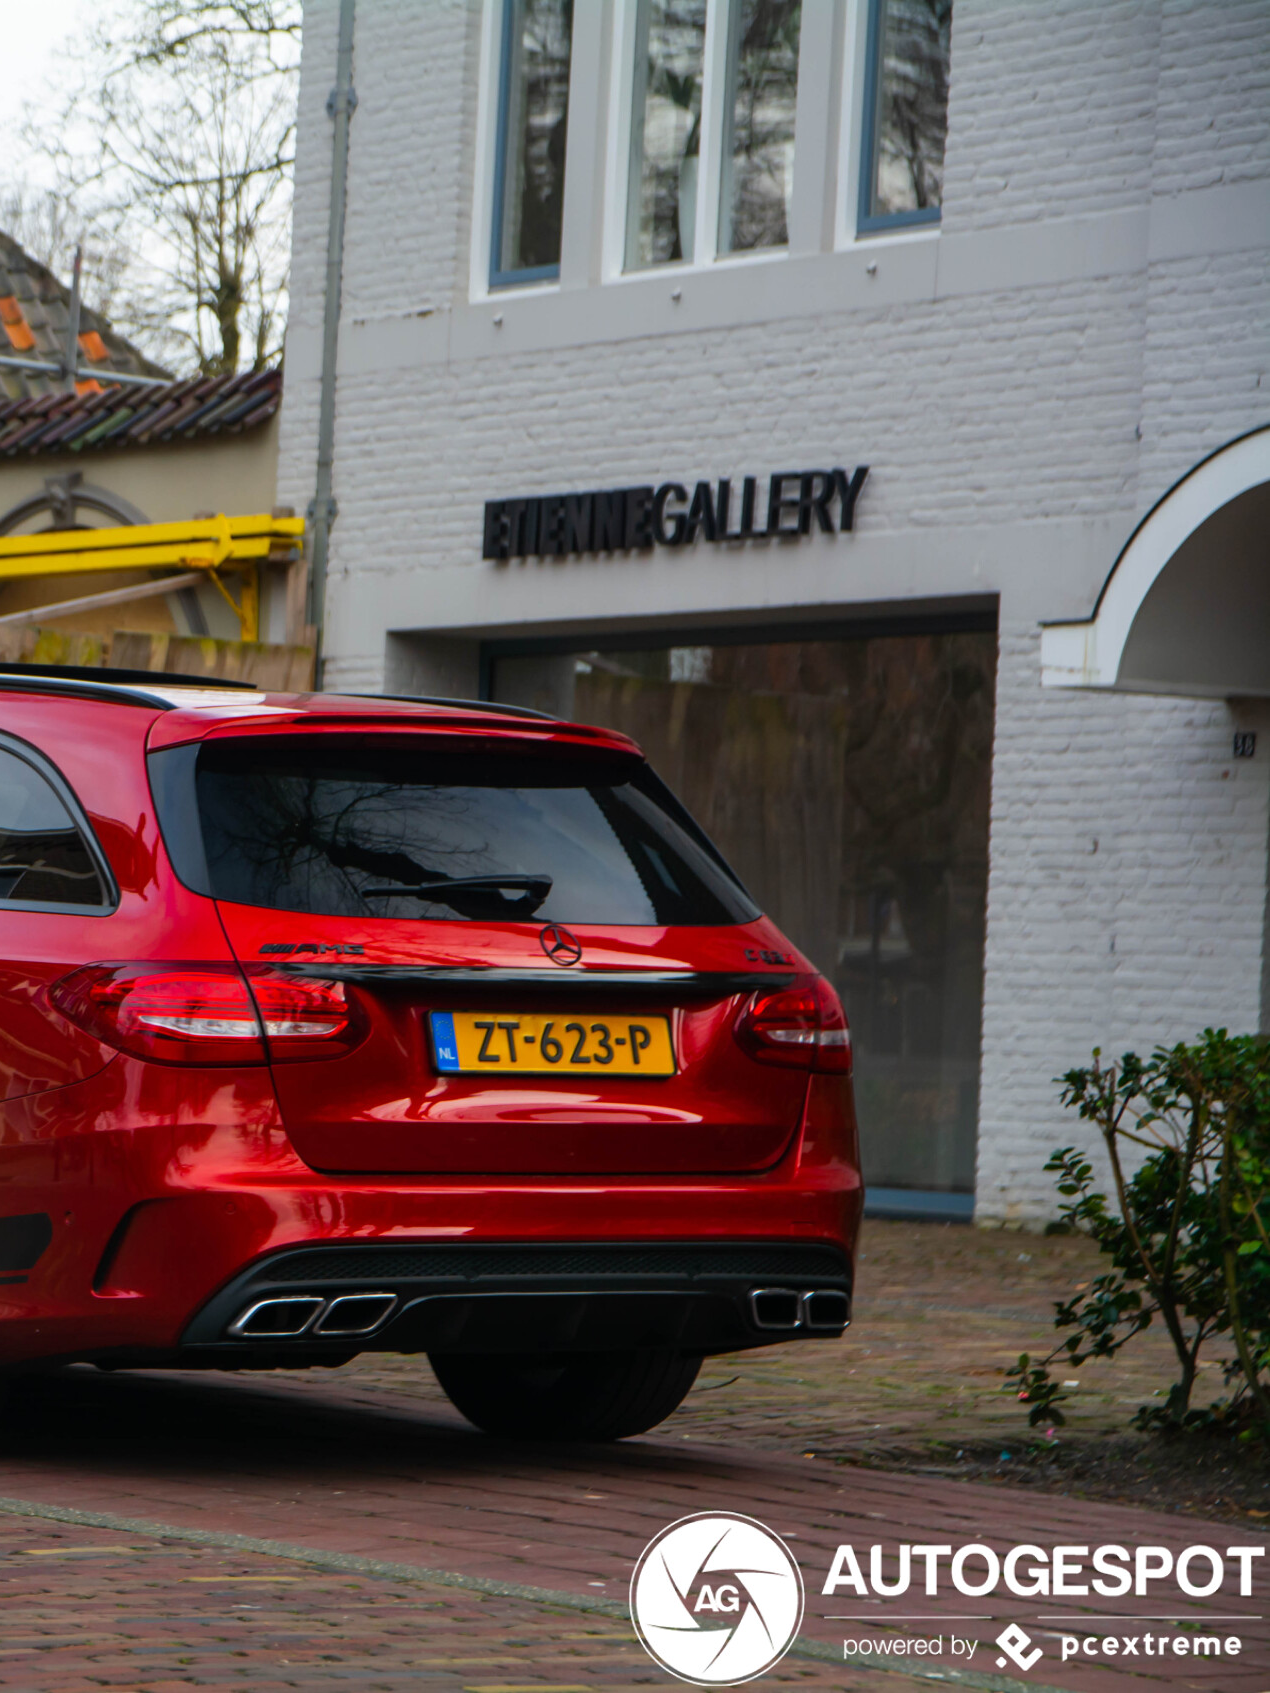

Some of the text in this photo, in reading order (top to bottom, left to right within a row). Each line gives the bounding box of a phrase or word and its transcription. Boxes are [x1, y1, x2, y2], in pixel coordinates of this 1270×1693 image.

[294, 943, 365, 955] AMG
[476, 1021, 651, 1065] ZT-623-P
[438, 1047, 457, 1062] NL
